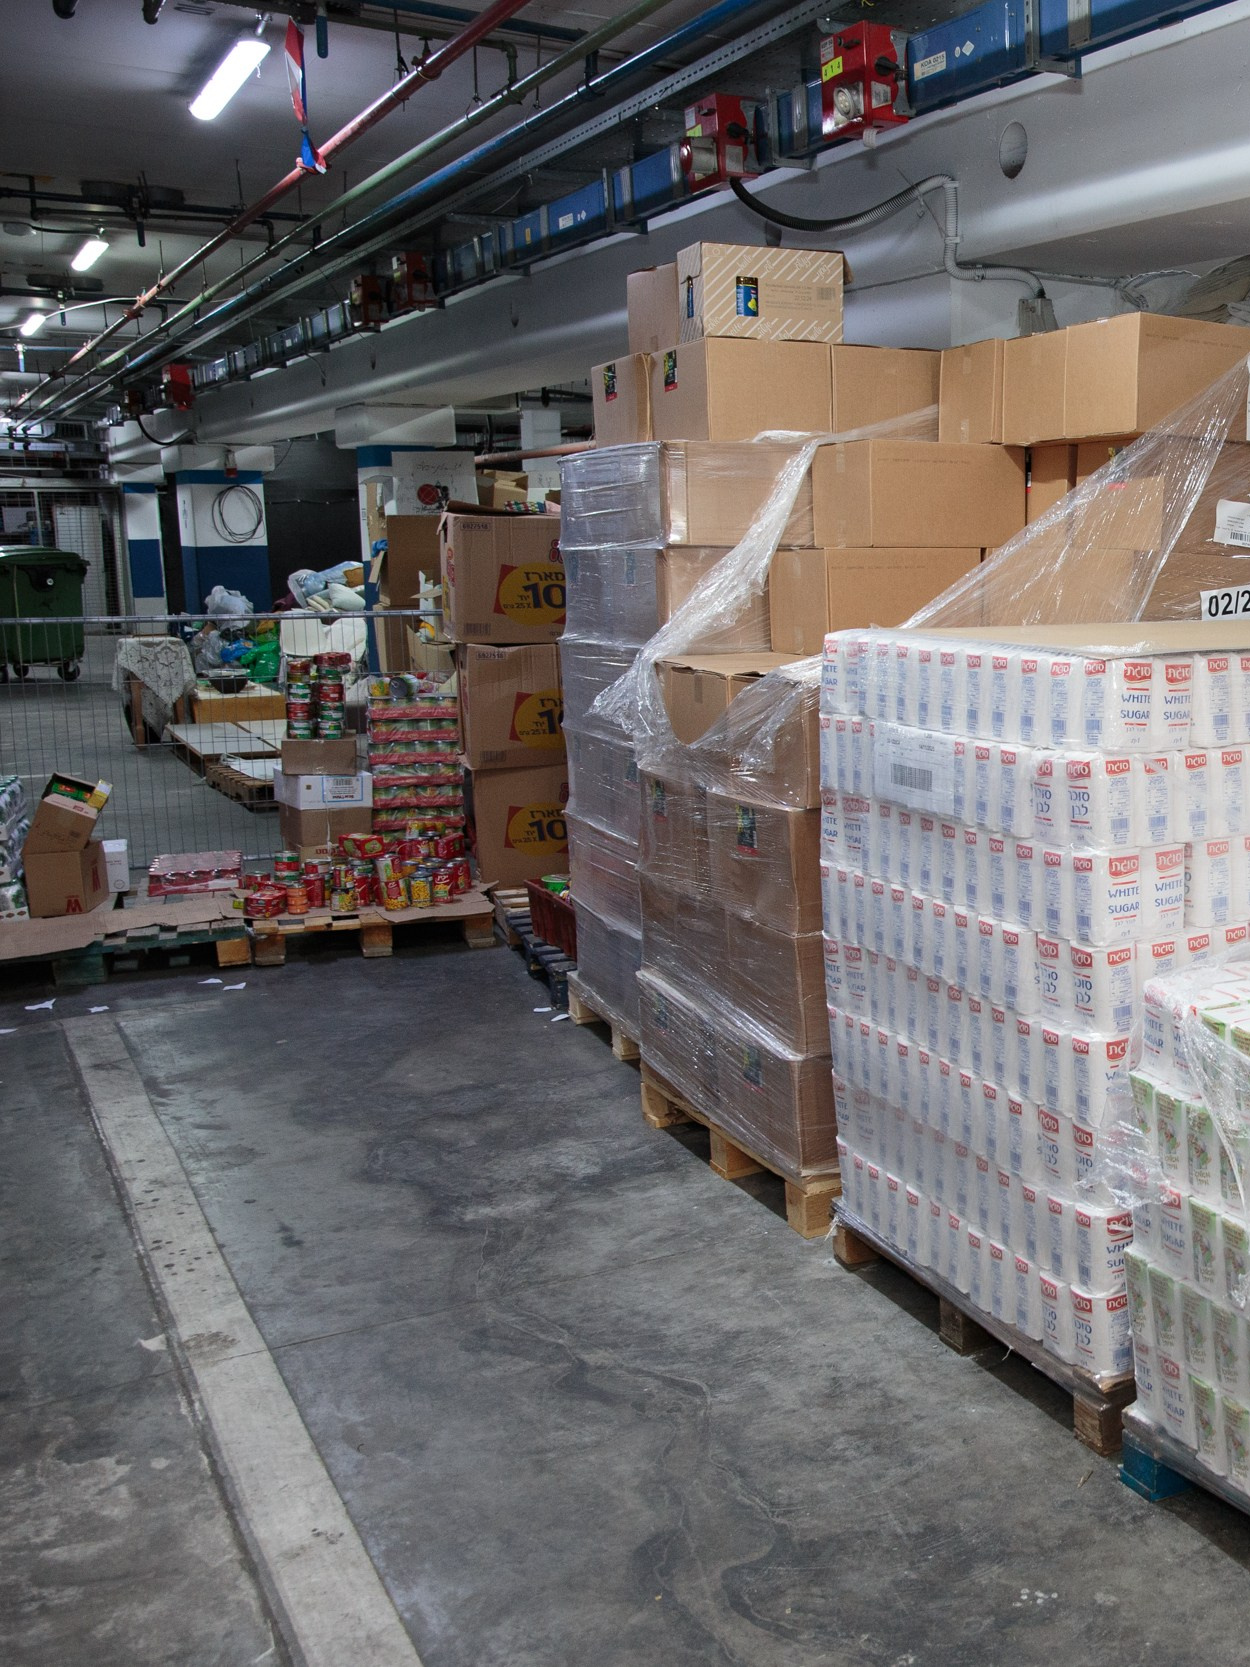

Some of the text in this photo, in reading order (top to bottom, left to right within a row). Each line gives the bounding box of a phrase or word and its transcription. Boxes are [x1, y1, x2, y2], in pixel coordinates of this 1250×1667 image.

[524, 571, 566, 581] מארז
[522, 583, 566, 609] 10
[1126, 665, 1151, 679] סוגת
[1208, 661, 1228, 671] סוגת
[1167, 668, 1191, 680] סוגת
[1164, 695, 1191, 705] WHIT
[1186, 756, 1207, 767] סוגת
[1223, 751, 1242, 762] סוגת
[1106, 763, 1129, 773] סוגת
[1068, 790, 1090, 802] סוכר
[1071, 803, 1089, 818] לבן
[528, 819, 568, 841] 10
[1209, 843, 1229, 854] סוגת
[1157, 852, 1184, 867] סוגת
[1111, 859, 1139, 873] סוגת
[1154, 879, 1183, 892] WHITE
[1108, 886, 1140, 898] WHITE
[1155, 894, 1183, 907] SUGAR
[1108, 901, 1140, 914] SUGAR
[1226, 928, 1246, 940] סוגת
[1153, 944, 1174, 955] סוגת
[1107, 951, 1130, 963] סוגת
[1107, 1242, 1133, 1254] WHIT
